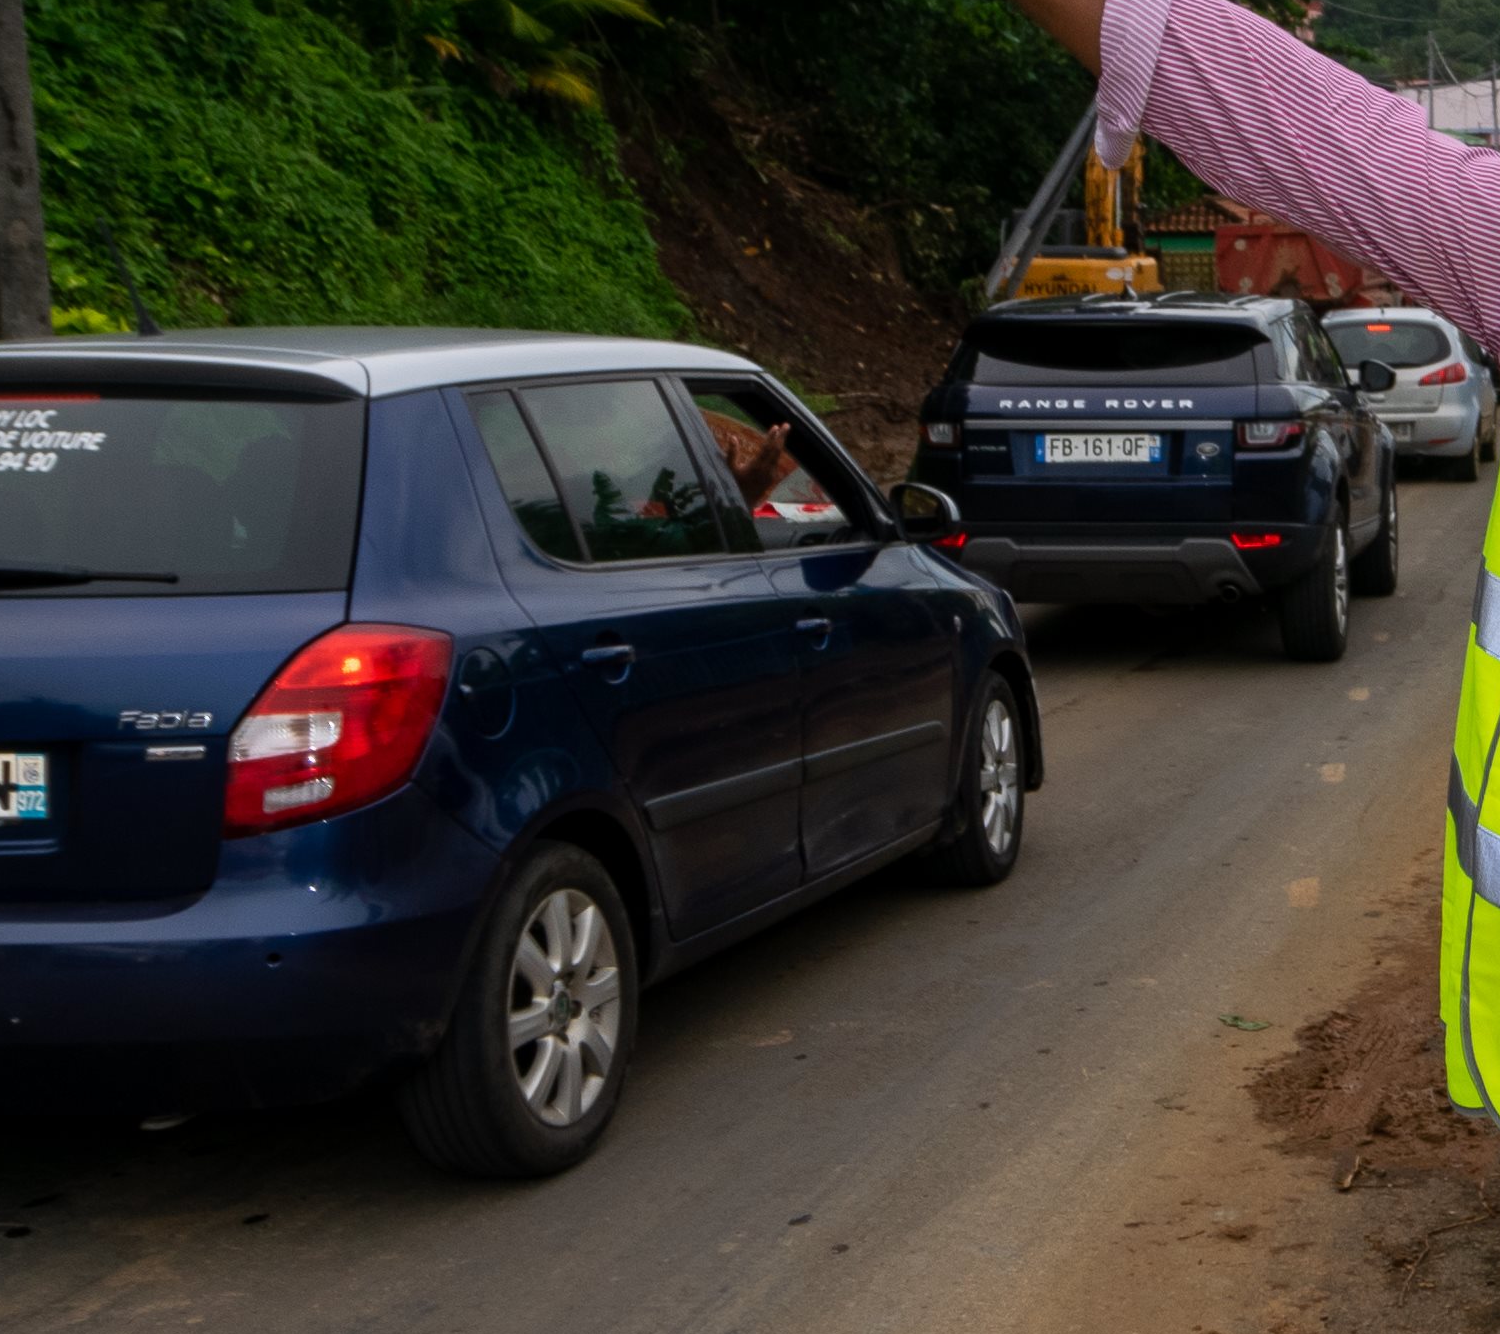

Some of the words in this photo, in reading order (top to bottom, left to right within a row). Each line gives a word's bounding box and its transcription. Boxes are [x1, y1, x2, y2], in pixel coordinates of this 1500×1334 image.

[1024, 282, 1097, 296] HYUNDAI
[999, 399, 1087, 409] RANGE
[1105, 399, 1194, 409] ROVER
[13, 410, 58, 428] LOC
[19, 431, 107, 451] VOITURE
[25, 452, 58, 472] 90
